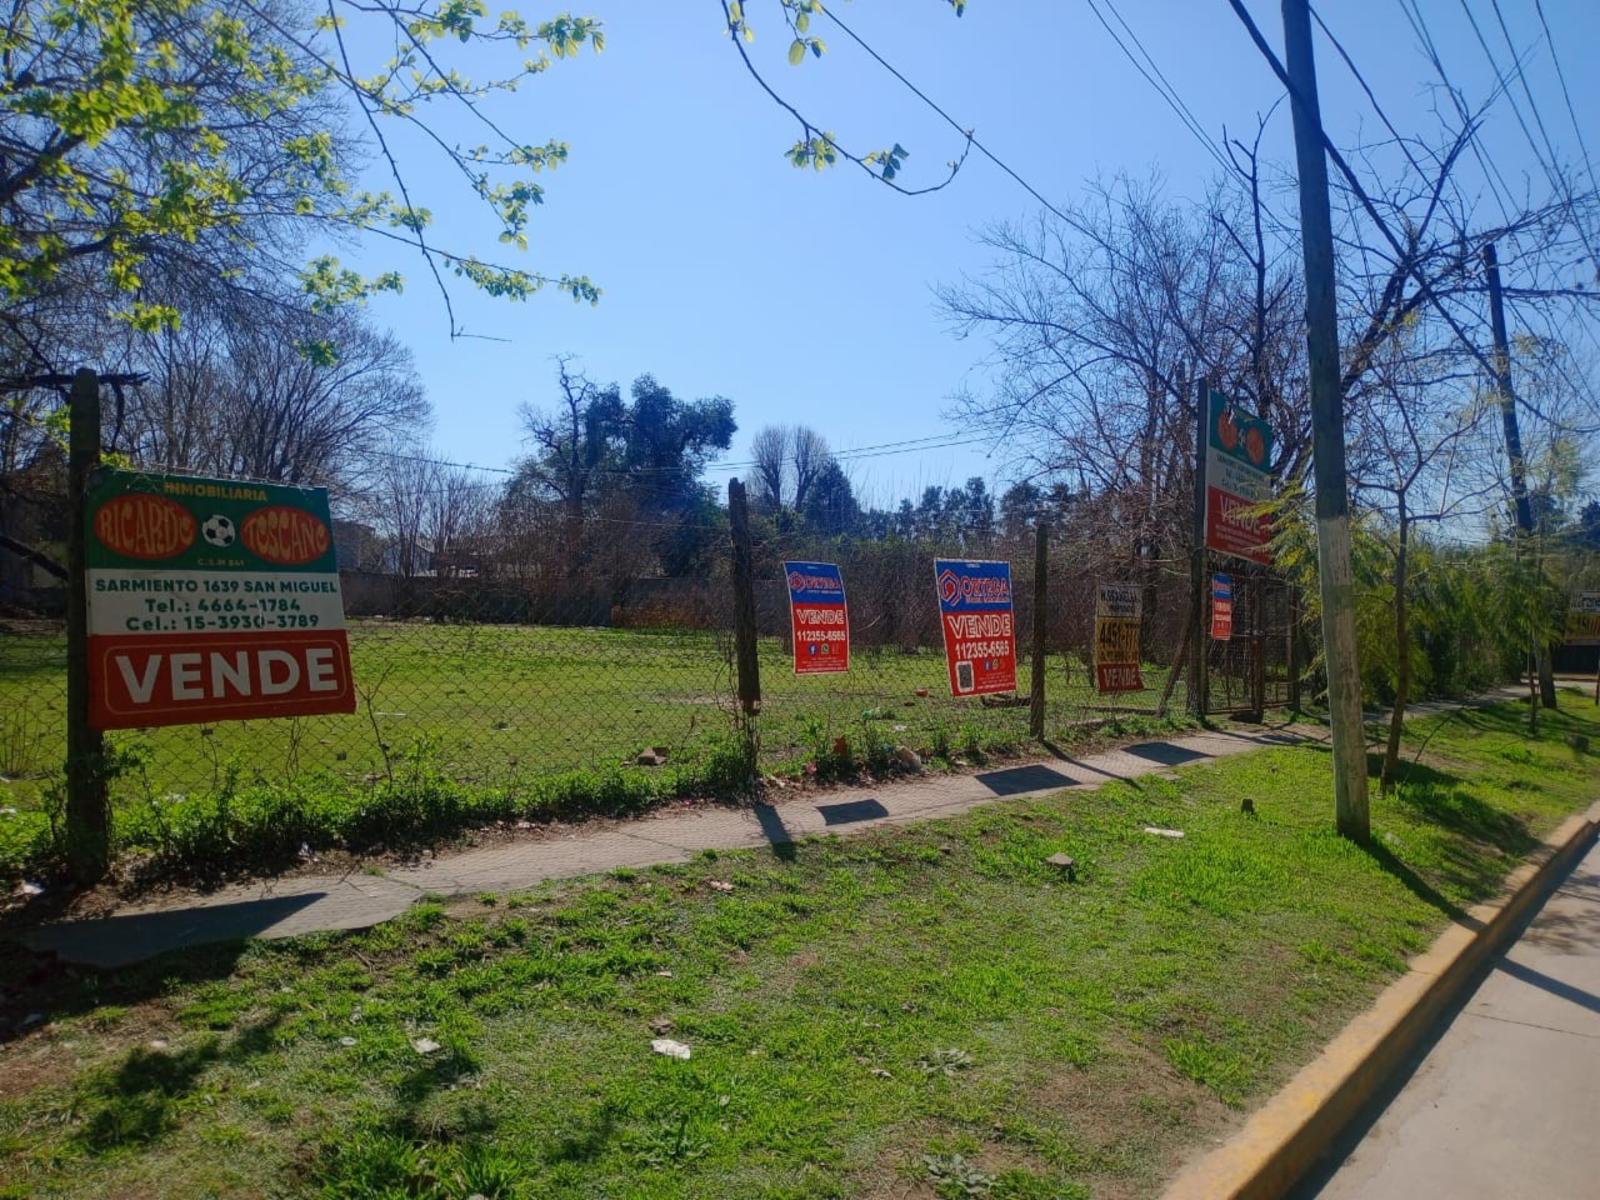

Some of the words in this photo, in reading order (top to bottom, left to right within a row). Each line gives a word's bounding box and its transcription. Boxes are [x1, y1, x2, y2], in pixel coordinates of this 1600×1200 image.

[164, 482, 267, 500] INMOBILIARIA
[100, 502, 194, 553] RICARDO
[246, 511, 328, 560] TOSCANO
[95, 578, 198, 593] SARMIENTO
[203, 579, 239, 593] 1639
[244, 580, 275, 593] SAN
[280, 580, 337, 593] MIGUEL
[144, 599, 191, 613] Tel.:
[197, 598, 300, 613] 4664-1784
[126, 616, 177, 631] Cel.:
[184, 614, 319, 630] 15-3930-3789
[796, 609, 844, 625] VENDE
[947, 613, 1011, 639] VENDE
[115, 648, 339, 705] VENDE
[1103, 667, 1138, 689] VENDE
